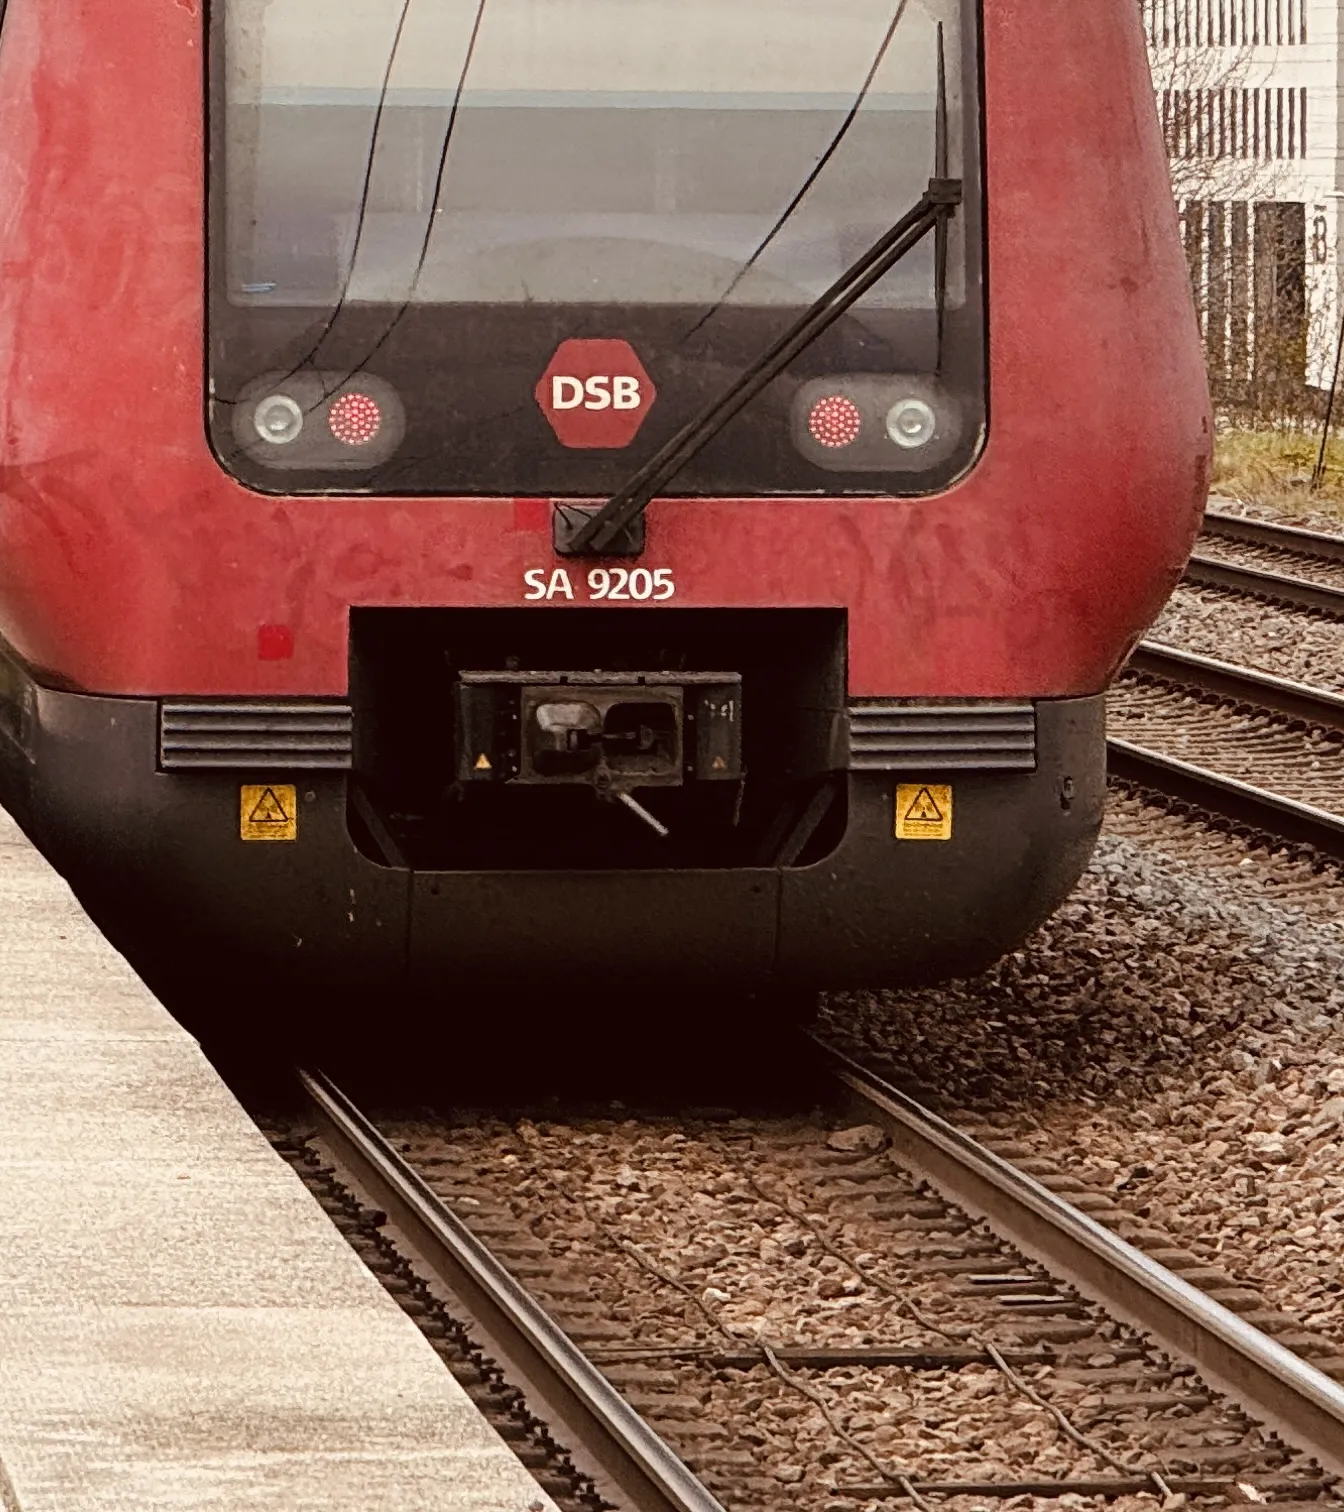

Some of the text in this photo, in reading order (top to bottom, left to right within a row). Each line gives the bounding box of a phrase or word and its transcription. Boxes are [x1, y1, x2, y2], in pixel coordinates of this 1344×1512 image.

[552, 375, 641, 411] DSB
[524, 568, 675, 600] SA 9205
